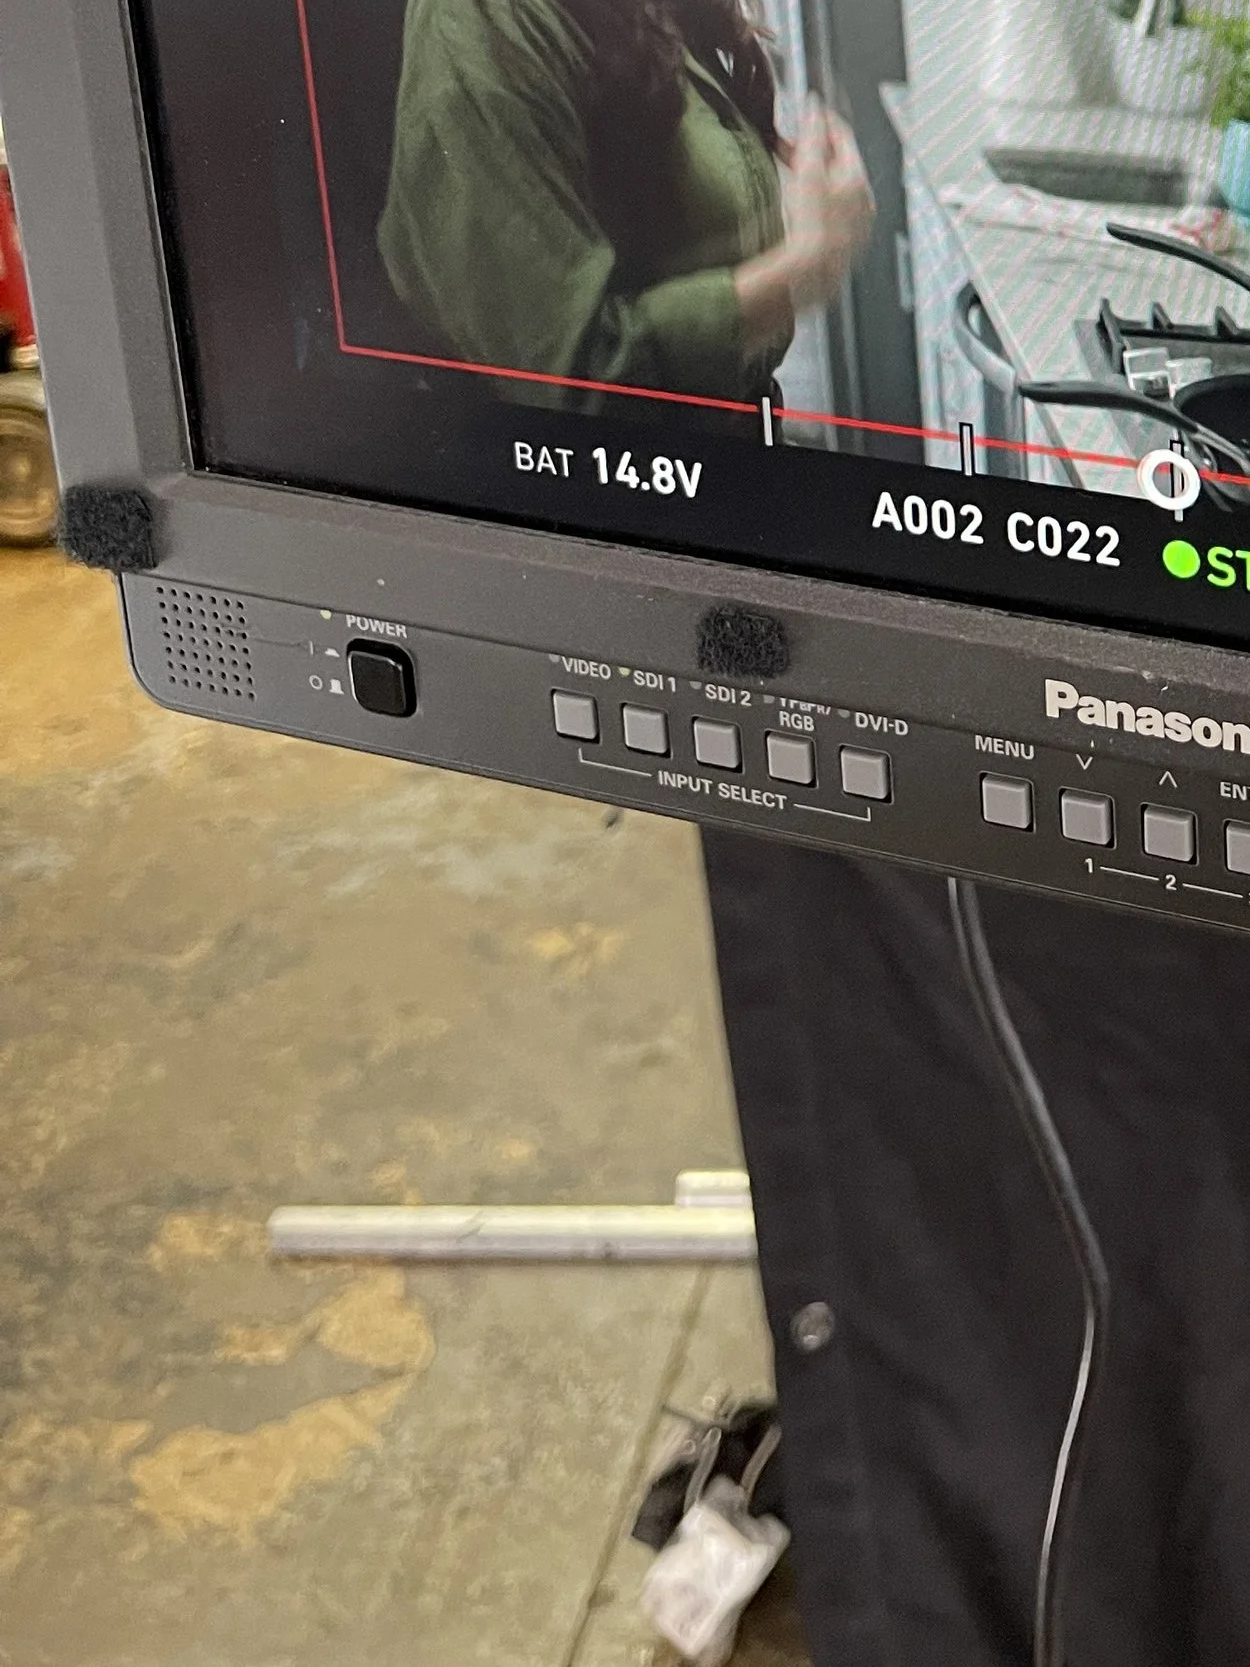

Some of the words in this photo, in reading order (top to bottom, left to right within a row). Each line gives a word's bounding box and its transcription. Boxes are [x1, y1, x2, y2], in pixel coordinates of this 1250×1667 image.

[514, 441, 574, 477] BAT
[591, 446, 703, 499] 14.8V
[872, 491, 984, 546] A002
[1006, 510, 1121, 568] C022
[345, 613, 408, 639] POWER
[563, 658, 611, 679] VIDEO
[633, 670, 666, 690] SDI
[667, 676, 677, 692] 1
[705, 684, 739, 704] SDI
[740, 693, 752, 706] 2
[779, 710, 815, 732] RGB
[855, 711, 909, 736] DVI-D
[974, 734, 1035, 760] MENU
[658, 770, 713, 797] INPUT
[718, 781, 787, 810] SELECT
[1084, 857, 1094, 874] 1
[1165, 874, 1177, 891] 2
